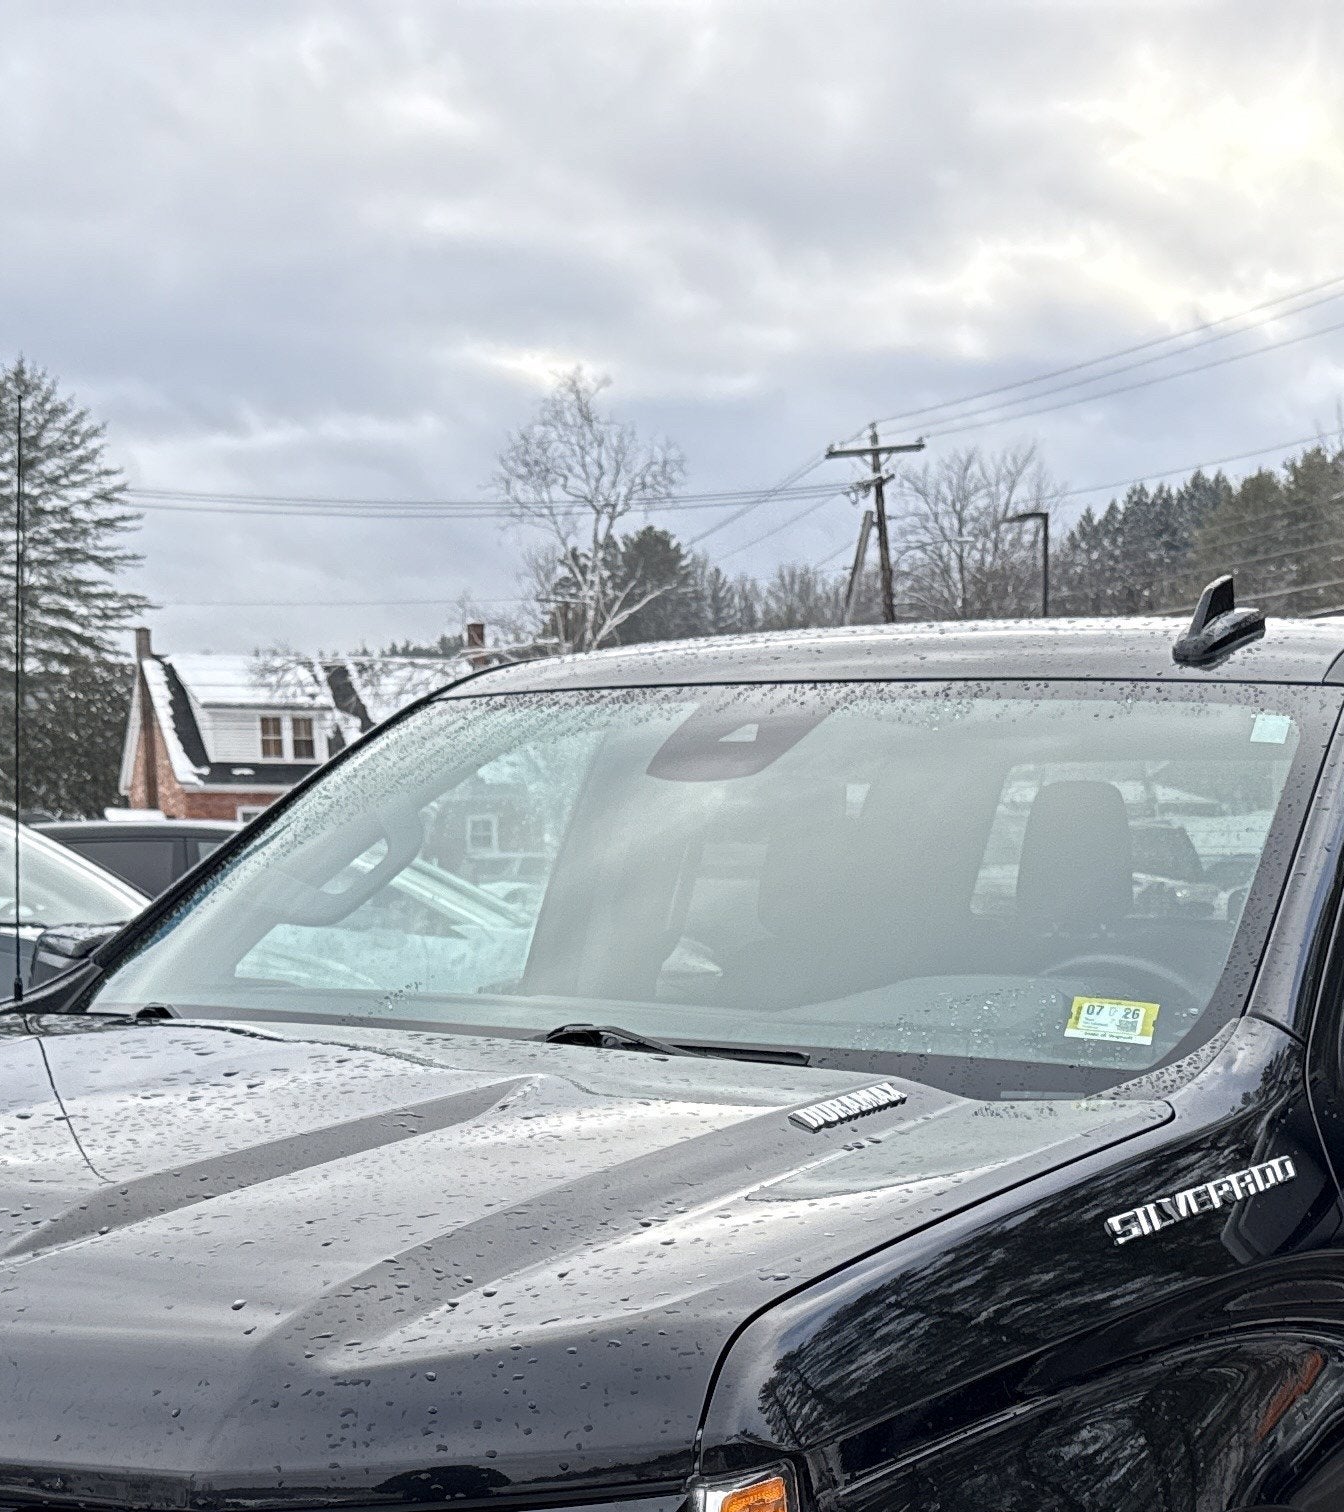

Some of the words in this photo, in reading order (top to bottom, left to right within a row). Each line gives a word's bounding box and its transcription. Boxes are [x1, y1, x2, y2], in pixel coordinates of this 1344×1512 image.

[1086, 1004, 1104, 1015] 07
[1122, 1008, 1140, 1019] 26
[788, 1082, 907, 1133] DURAMAX
[1104, 1155, 1298, 1245] SILVERADO
